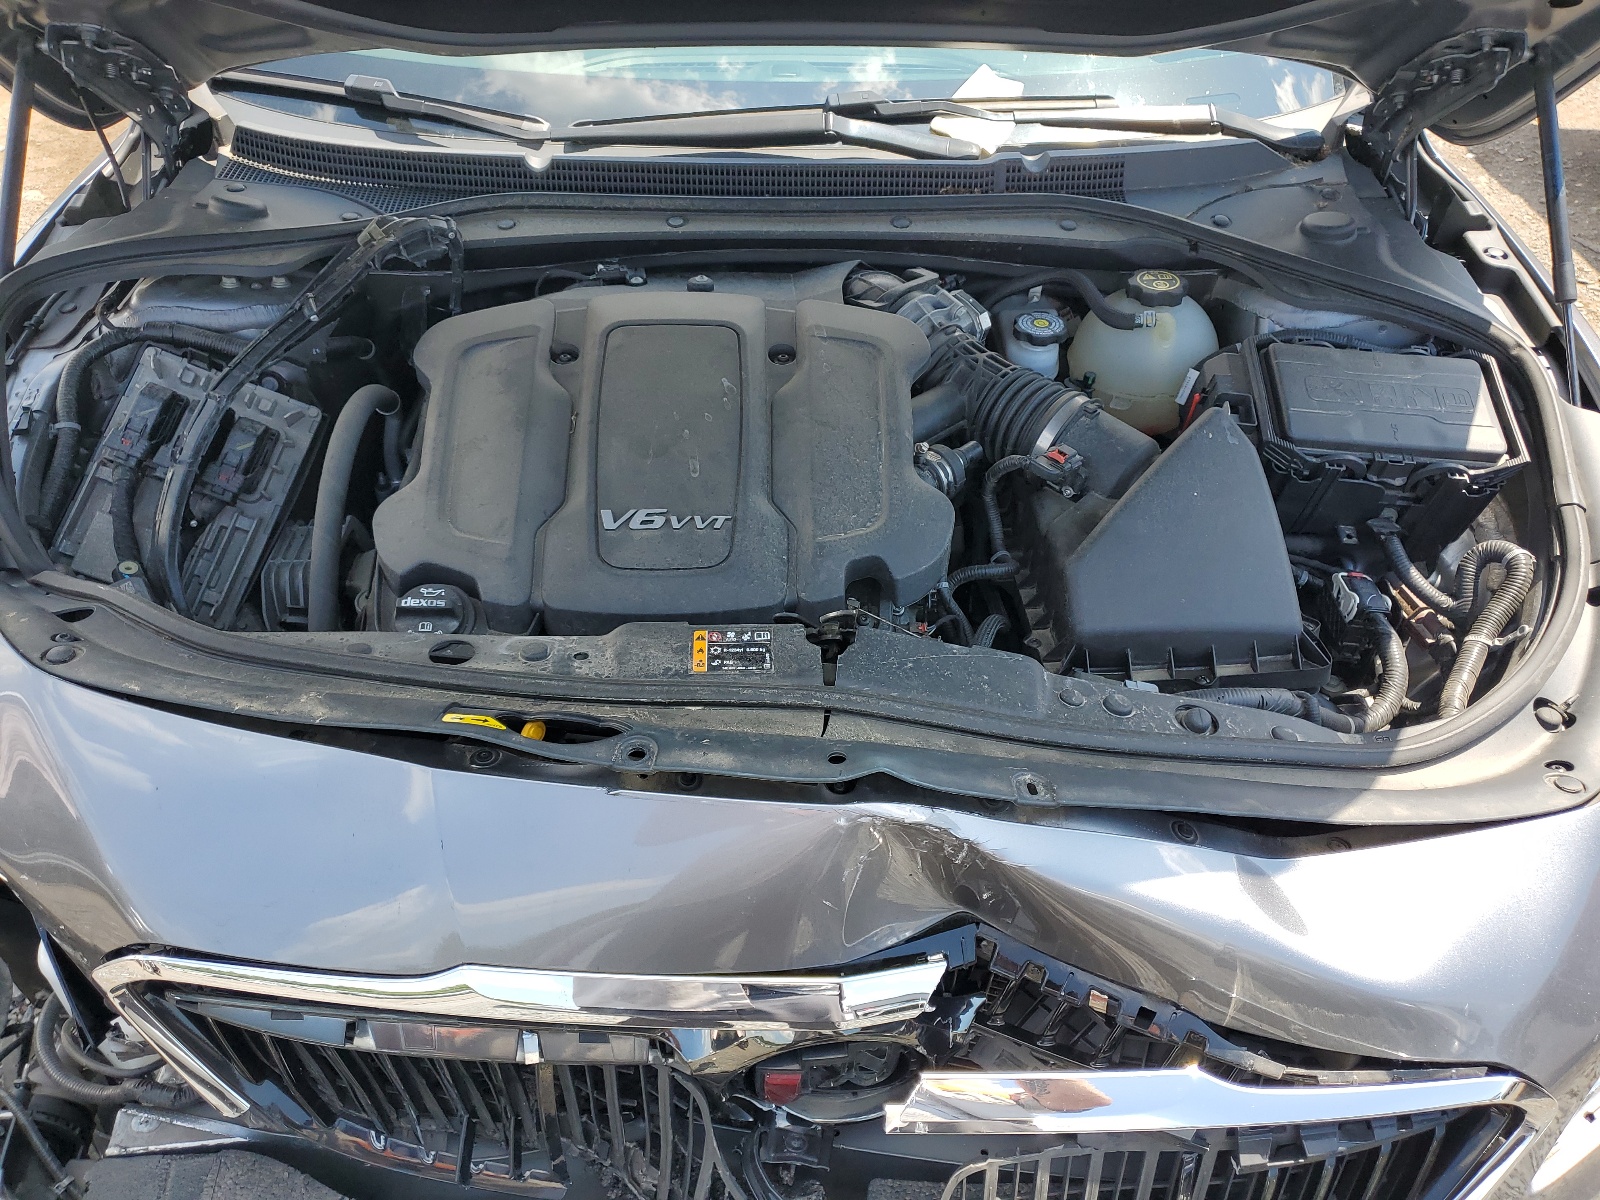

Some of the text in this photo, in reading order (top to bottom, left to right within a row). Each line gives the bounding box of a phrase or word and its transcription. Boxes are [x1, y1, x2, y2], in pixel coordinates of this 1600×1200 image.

[600, 508, 732, 530] V6 VVT
[401, 597, 446, 607] dexos
